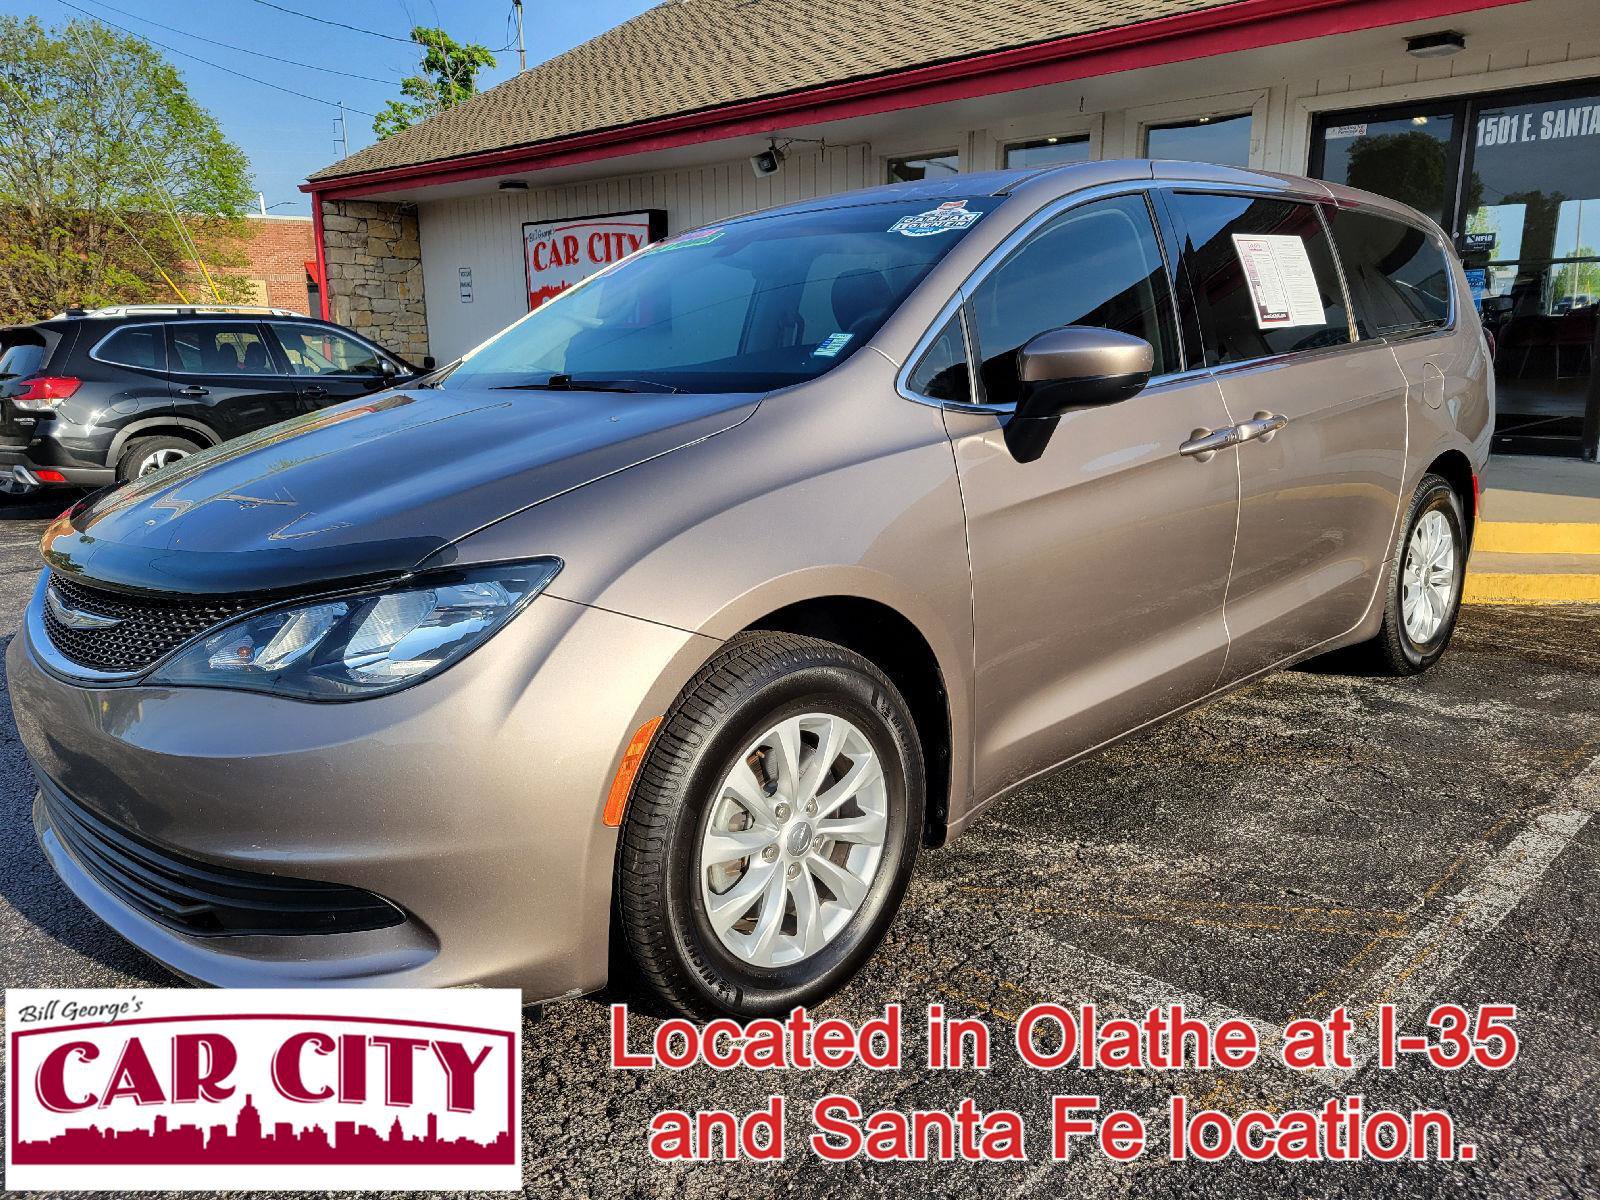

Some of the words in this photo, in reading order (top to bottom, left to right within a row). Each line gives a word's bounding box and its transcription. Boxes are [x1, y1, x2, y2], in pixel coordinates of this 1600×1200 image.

[1477, 114, 1519, 147] 1501
[1521, 113, 1536, 142] E.
[1540, 105, 1600, 140] SANTA
[904, 215, 972, 223] CARFAX
[533, 235, 580, 272] CAR
[588, 232, 643, 264] CITY
